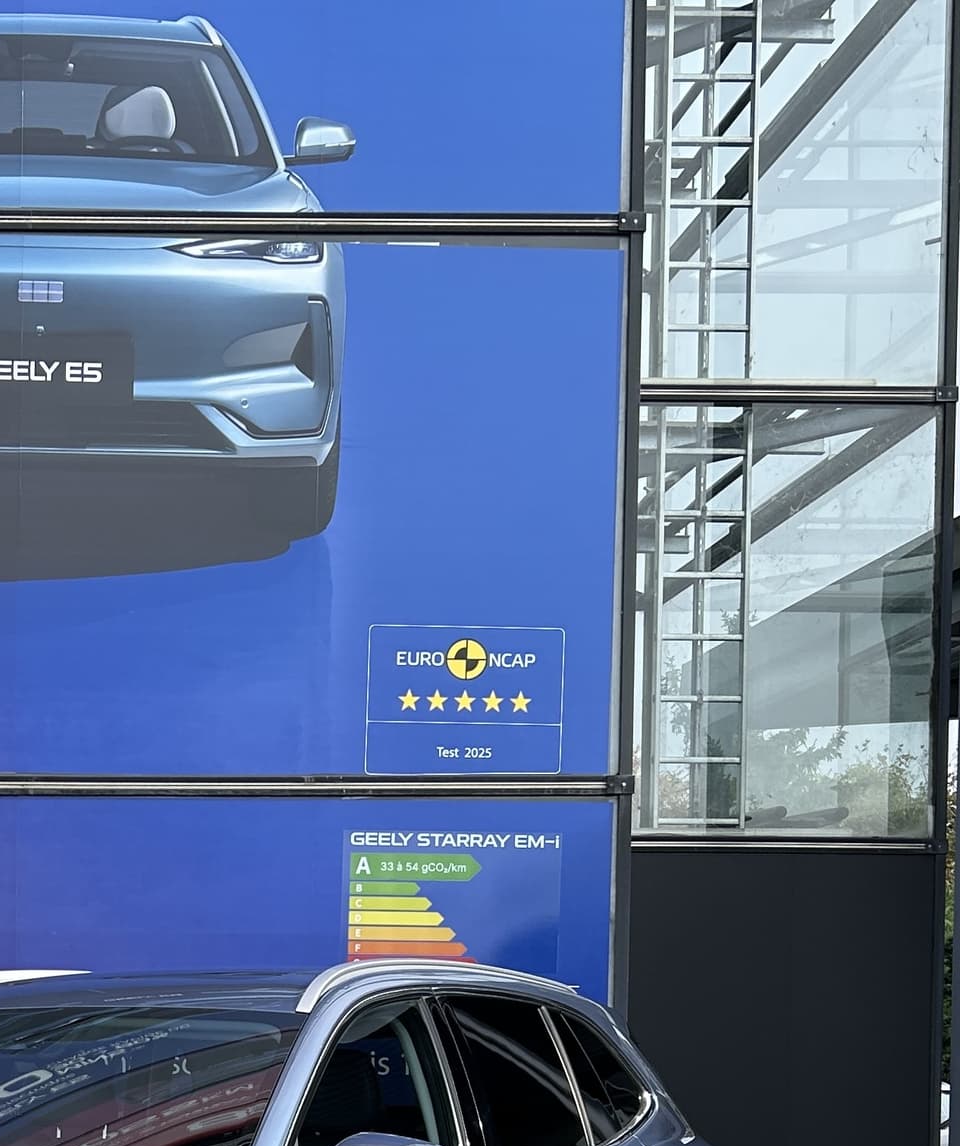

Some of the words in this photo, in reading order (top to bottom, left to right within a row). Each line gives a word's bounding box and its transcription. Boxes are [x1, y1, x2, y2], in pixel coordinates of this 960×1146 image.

[65, 362, 102, 382] E5
[396, 651, 445, 666] EURO
[489, 653, 536, 668] NCAP
[436, 747, 459, 758] Test
[464, 748, 492, 758] 2025
[350, 832, 414, 847] GEELY
[417, 833, 511, 848] STARRAY
[514, 834, 560, 849] EM-i
[355, 857, 371, 875] A
[380, 862, 394, 871] 33
[396, 860, 403, 871] à
[406, 862, 419, 871] 54
[355, 884, 363, 892] B
[355, 899, 363, 907] C
[354, 914, 362, 922] D
[355, 929, 361, 937] E
[354, 944, 361, 952] F
